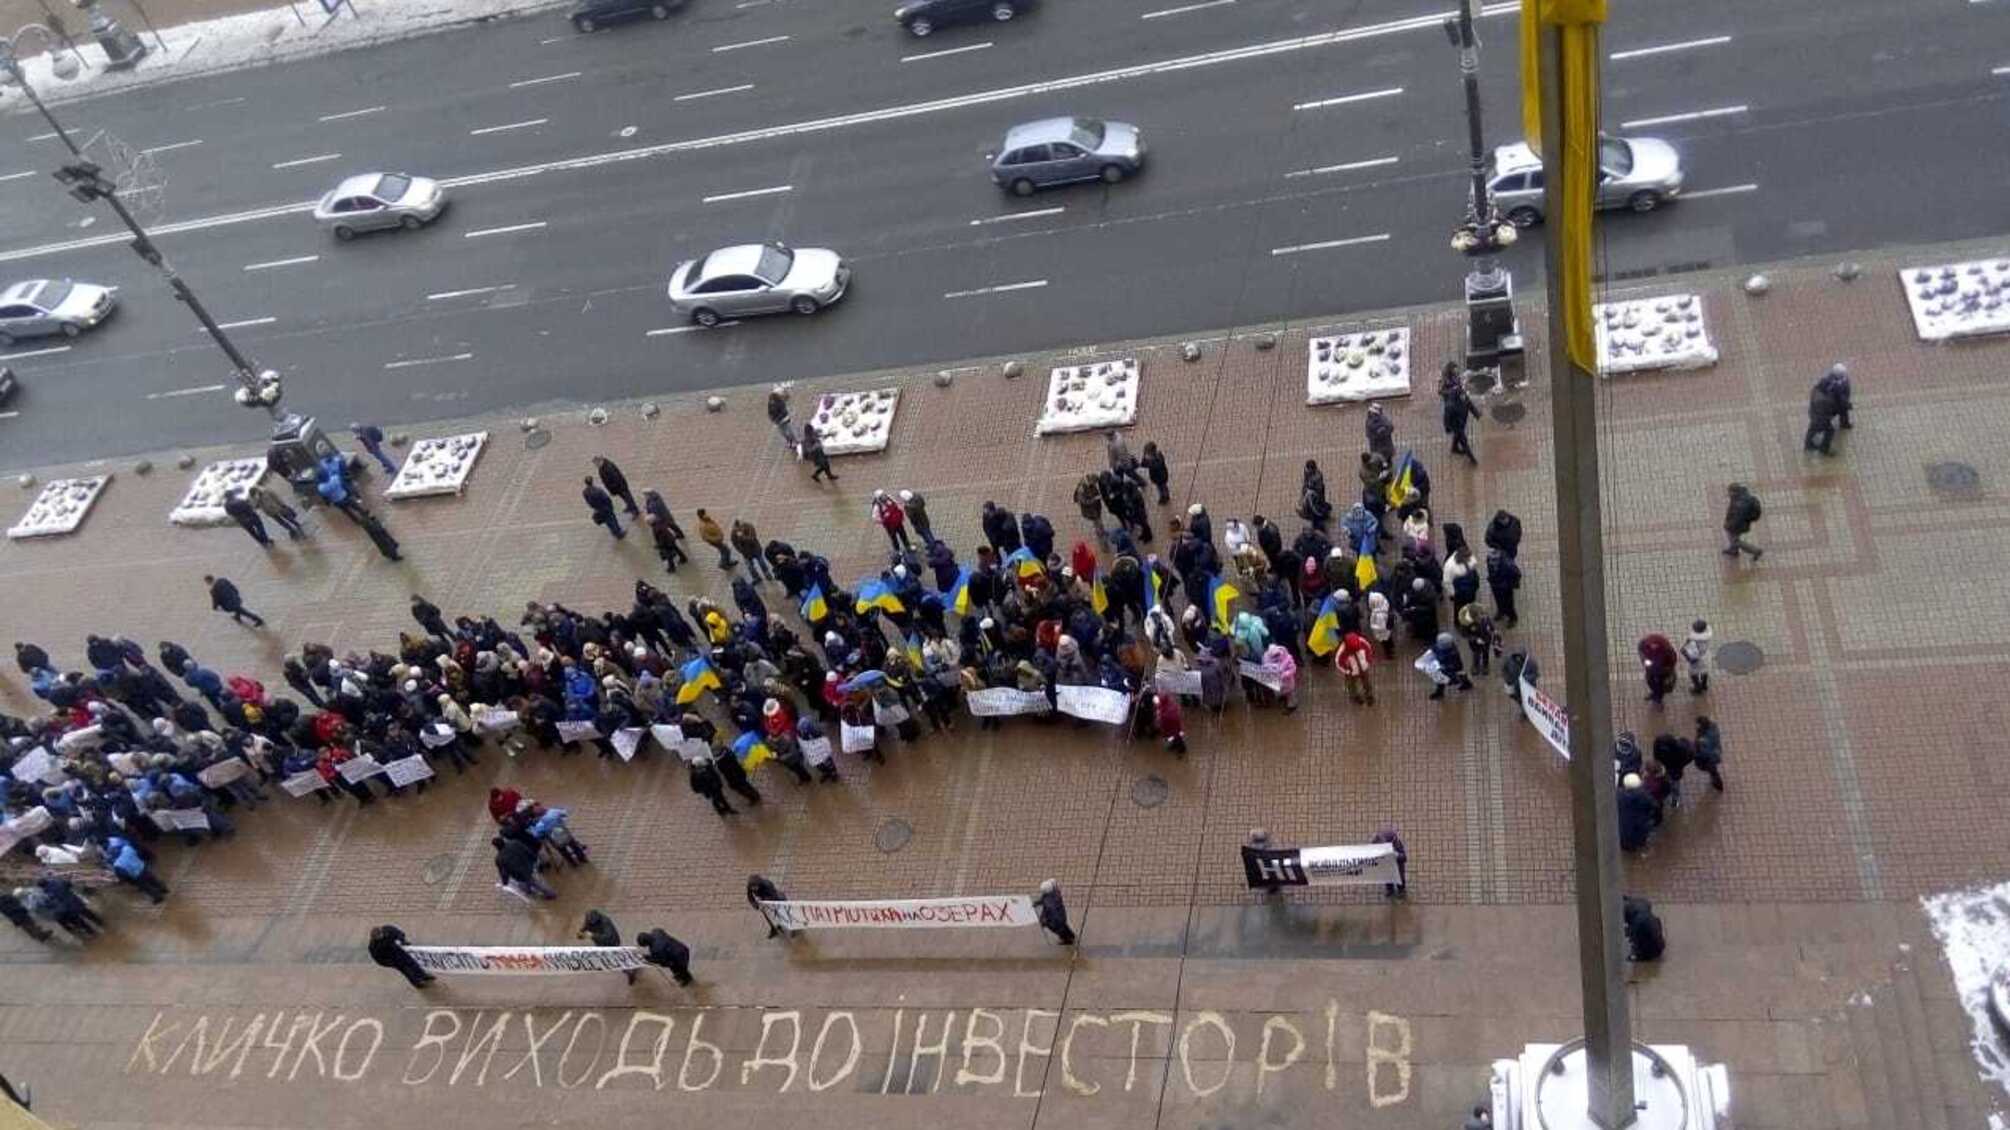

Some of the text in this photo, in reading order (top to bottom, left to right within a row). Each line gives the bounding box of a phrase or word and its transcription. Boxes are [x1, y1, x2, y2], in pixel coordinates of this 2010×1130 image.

[126, 998, 1413, 1107] КЛИЧКО ВИХОДЬ ДО ІНВЕСТОРІВ
